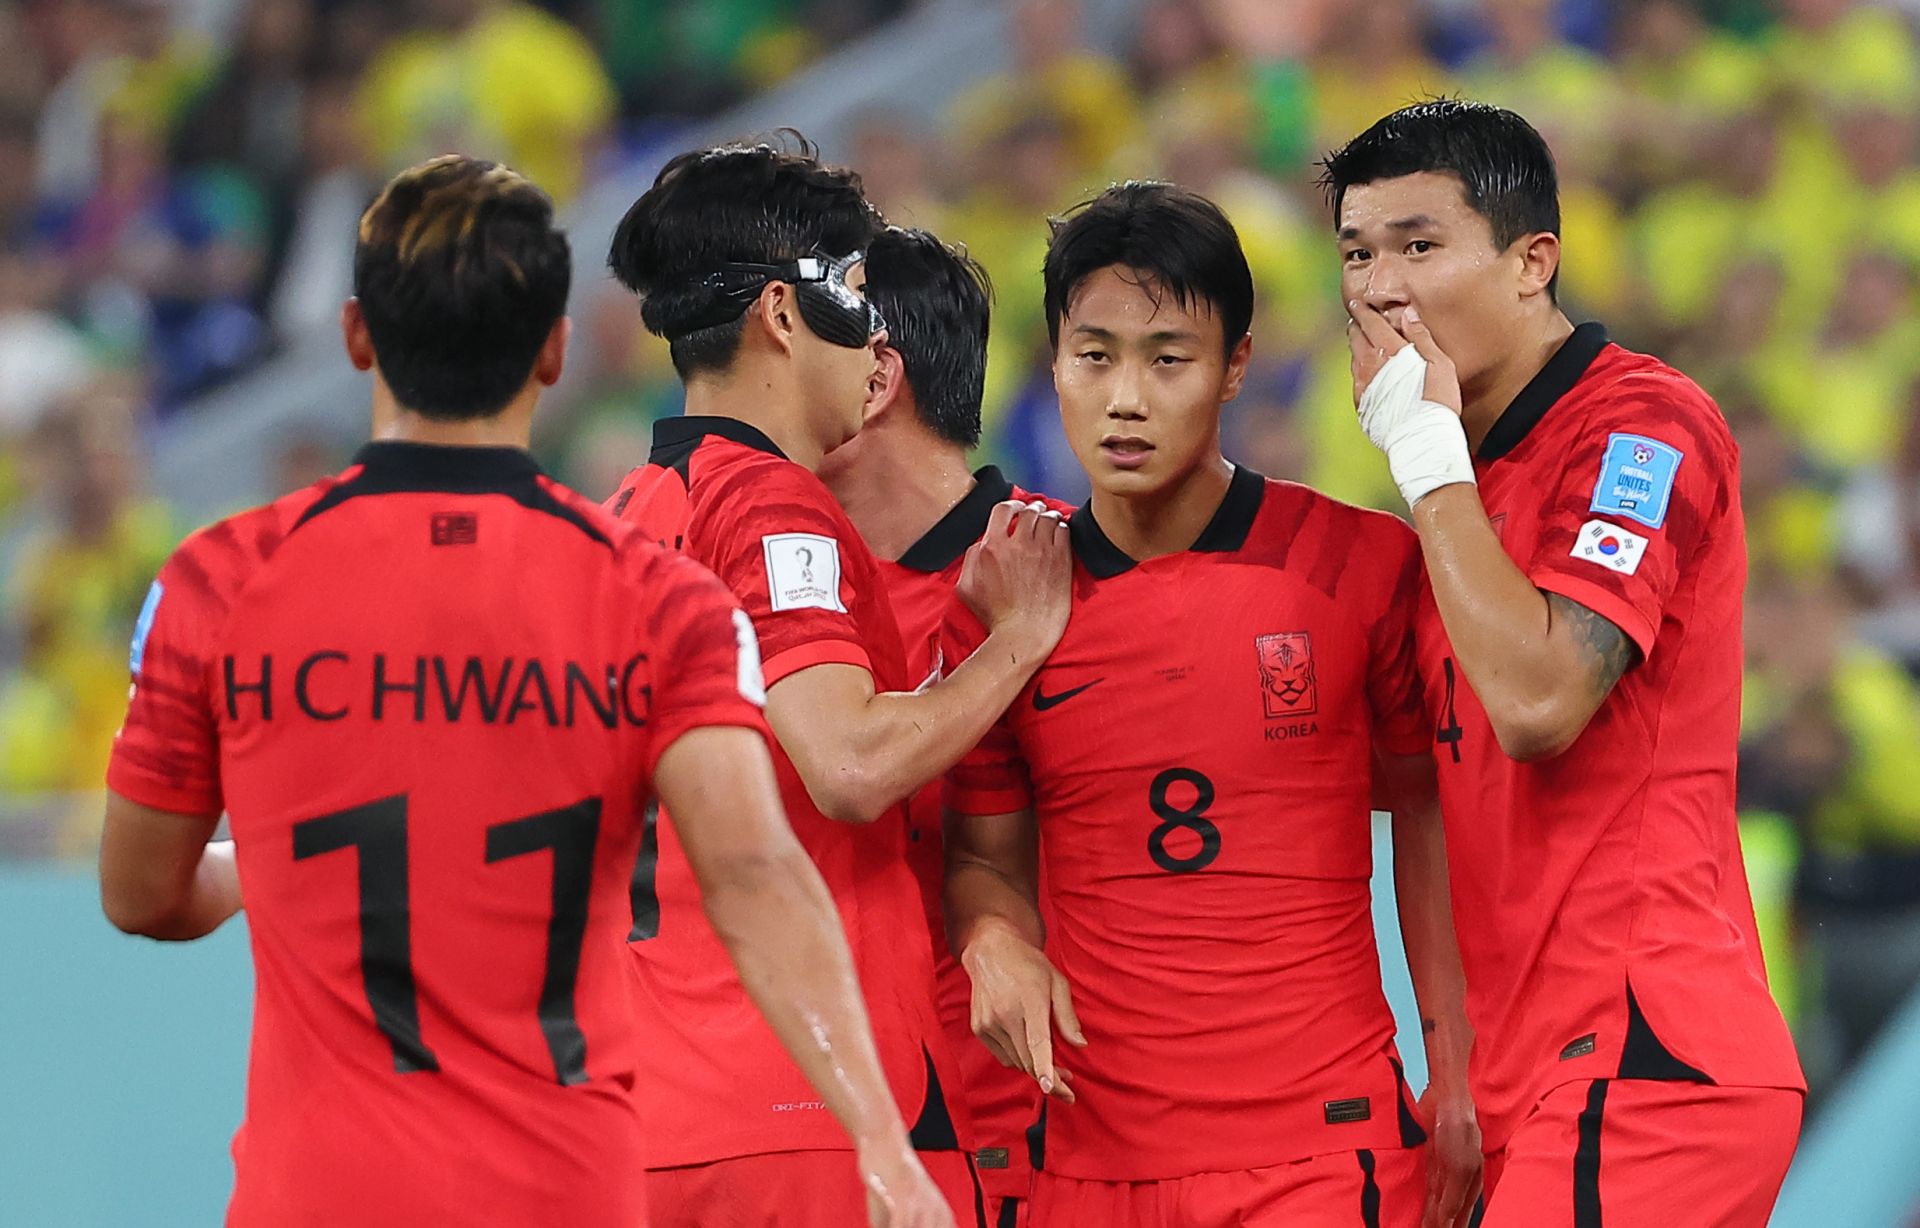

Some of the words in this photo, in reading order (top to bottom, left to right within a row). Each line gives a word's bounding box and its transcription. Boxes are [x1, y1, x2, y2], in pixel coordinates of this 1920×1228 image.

[1617, 474, 1652, 491] UNITES
[225, 656, 273, 721] H
[295, 652, 350, 720] C
[373, 653, 650, 728] HWANG
[1265, 721, 1319, 741] KOREA
[1437, 657, 1462, 763] 4
[1149, 767, 1220, 872] 8
[293, 792, 602, 1086] 11
